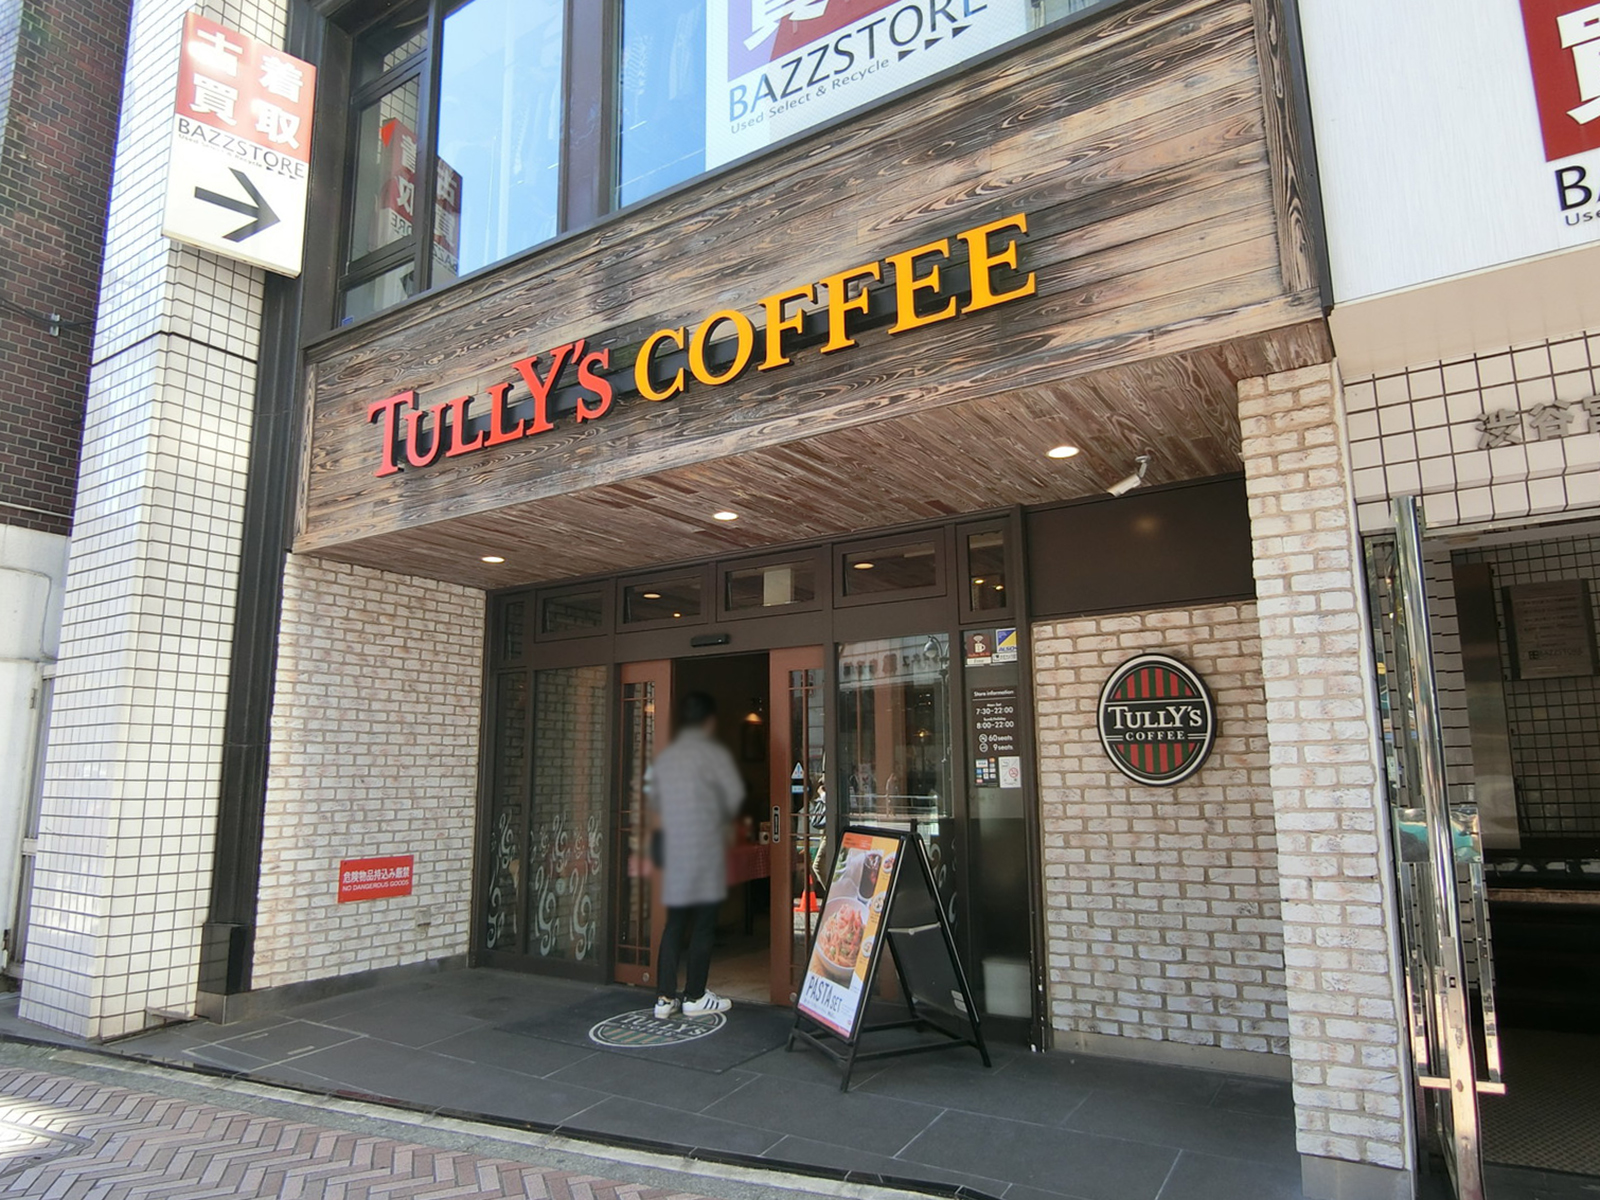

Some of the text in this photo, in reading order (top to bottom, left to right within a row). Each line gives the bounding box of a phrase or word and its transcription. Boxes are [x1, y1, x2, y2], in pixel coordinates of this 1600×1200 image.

[189, 73, 300, 150] 買取
[731, 58, 889, 134] Used Select & Recycle
[178, 118, 305, 178] BAZZSTORE
[634, 212, 1037, 401] COFFEE
[1125, 731, 1185, 741] COFFEE
[342, 879, 409, 892] NO DANGEROUS GOODS
[805, 976, 833, 1008] PASTA
[829, 995, 843, 1013] SET
